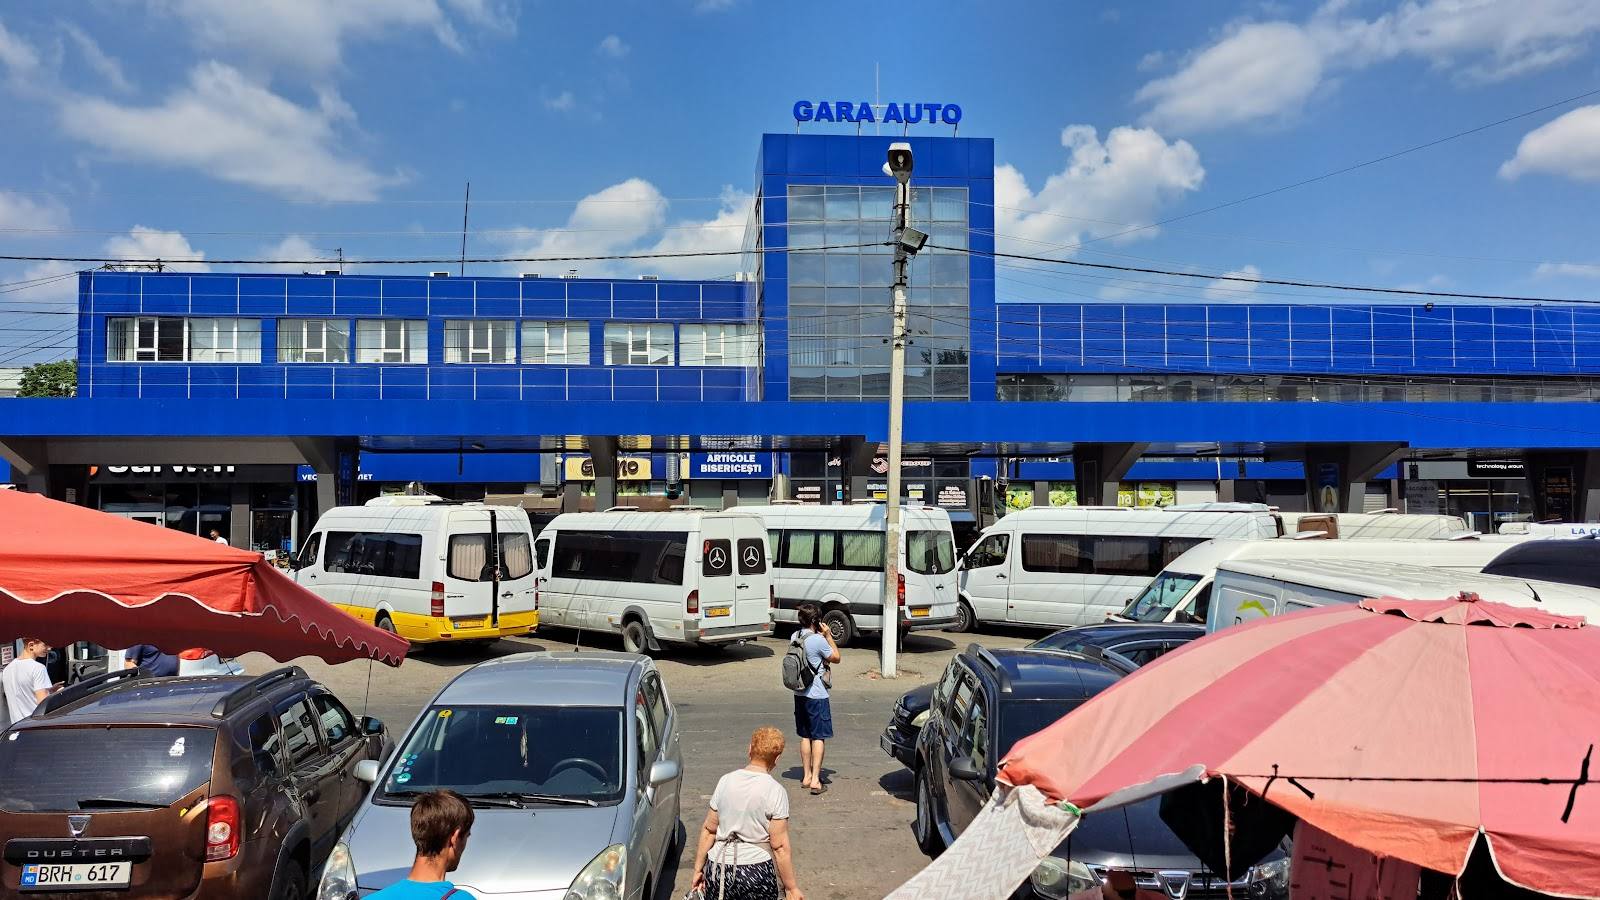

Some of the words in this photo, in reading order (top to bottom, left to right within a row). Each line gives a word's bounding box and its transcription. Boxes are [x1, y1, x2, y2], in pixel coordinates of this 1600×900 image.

[793, 100, 875, 122] GARA
[883, 102, 963, 124] AUTO
[706, 454, 756, 463] ARTICOLE
[27, 848, 123, 858] DUSTER
[38, 866, 73, 883] BRH
[87, 865, 120, 881] 617
